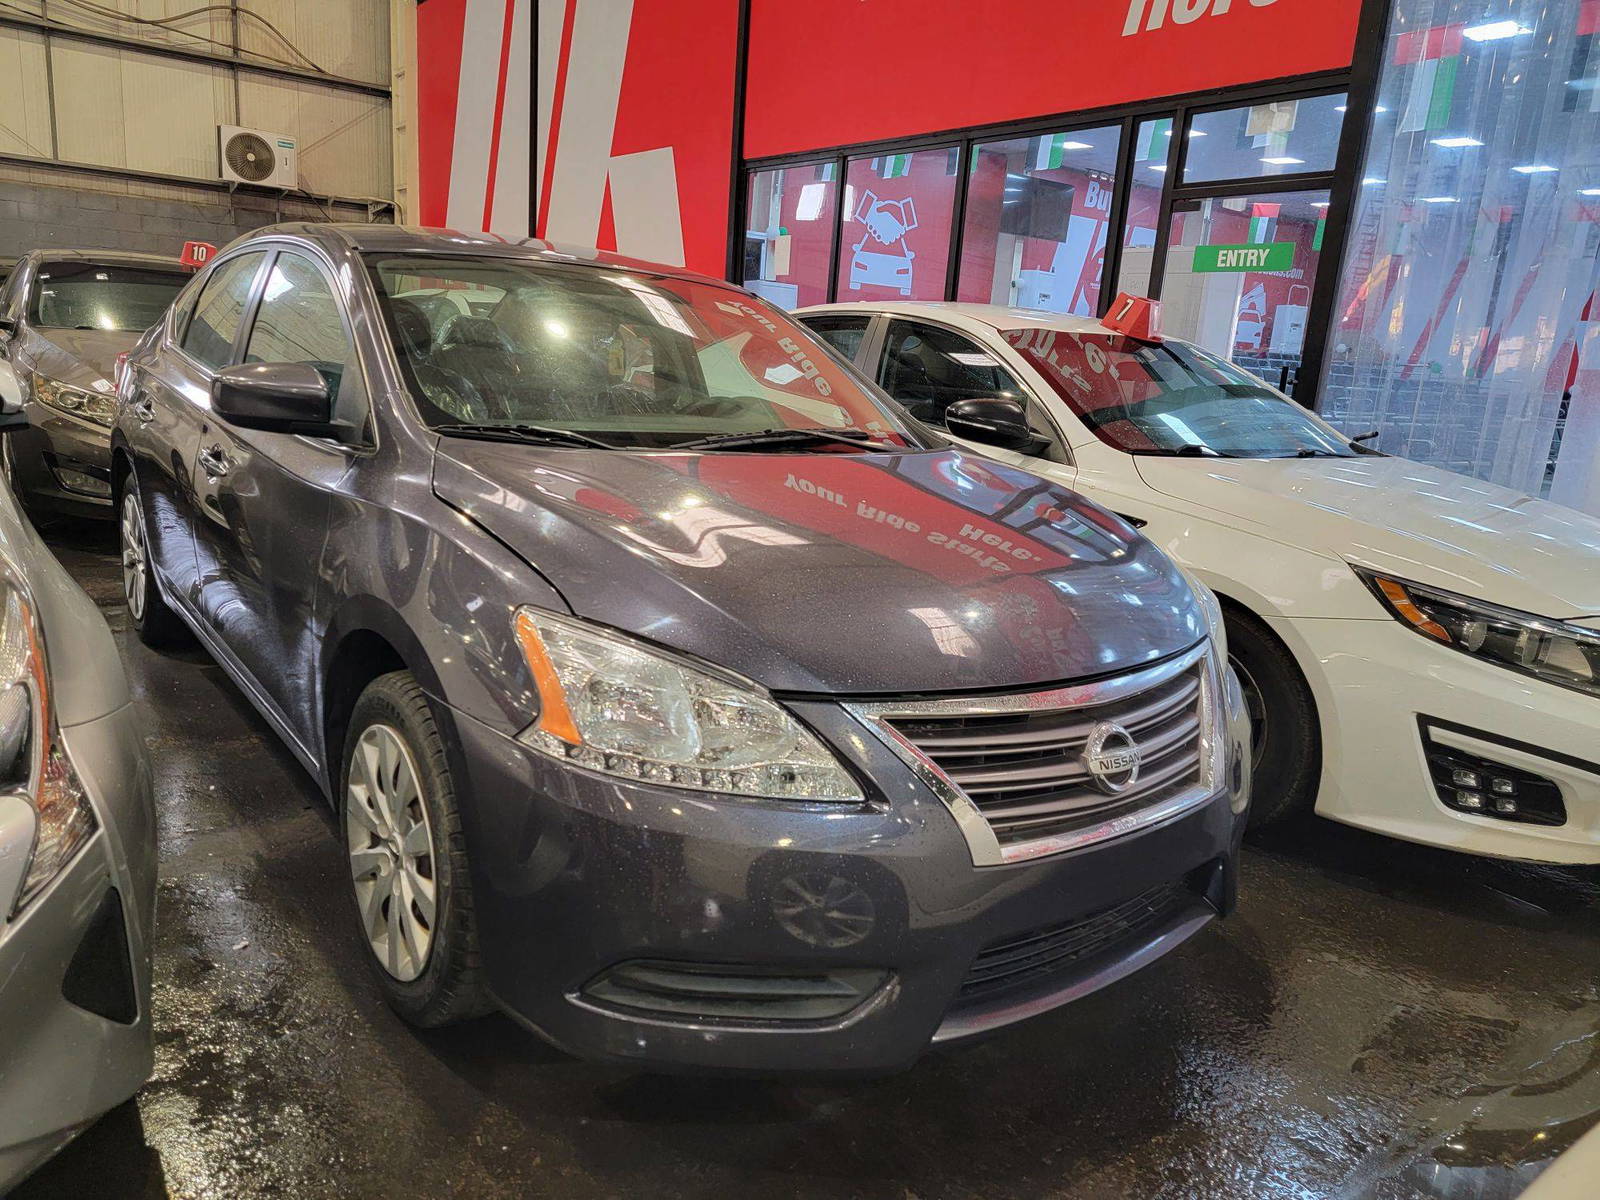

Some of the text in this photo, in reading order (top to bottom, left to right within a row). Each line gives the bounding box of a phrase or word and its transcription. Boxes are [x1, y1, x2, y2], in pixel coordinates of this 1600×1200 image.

[193, 246, 207, 261] 10
[1217, 249, 1270, 267] ENTRY
[1099, 751, 1141, 770] NISSAN
